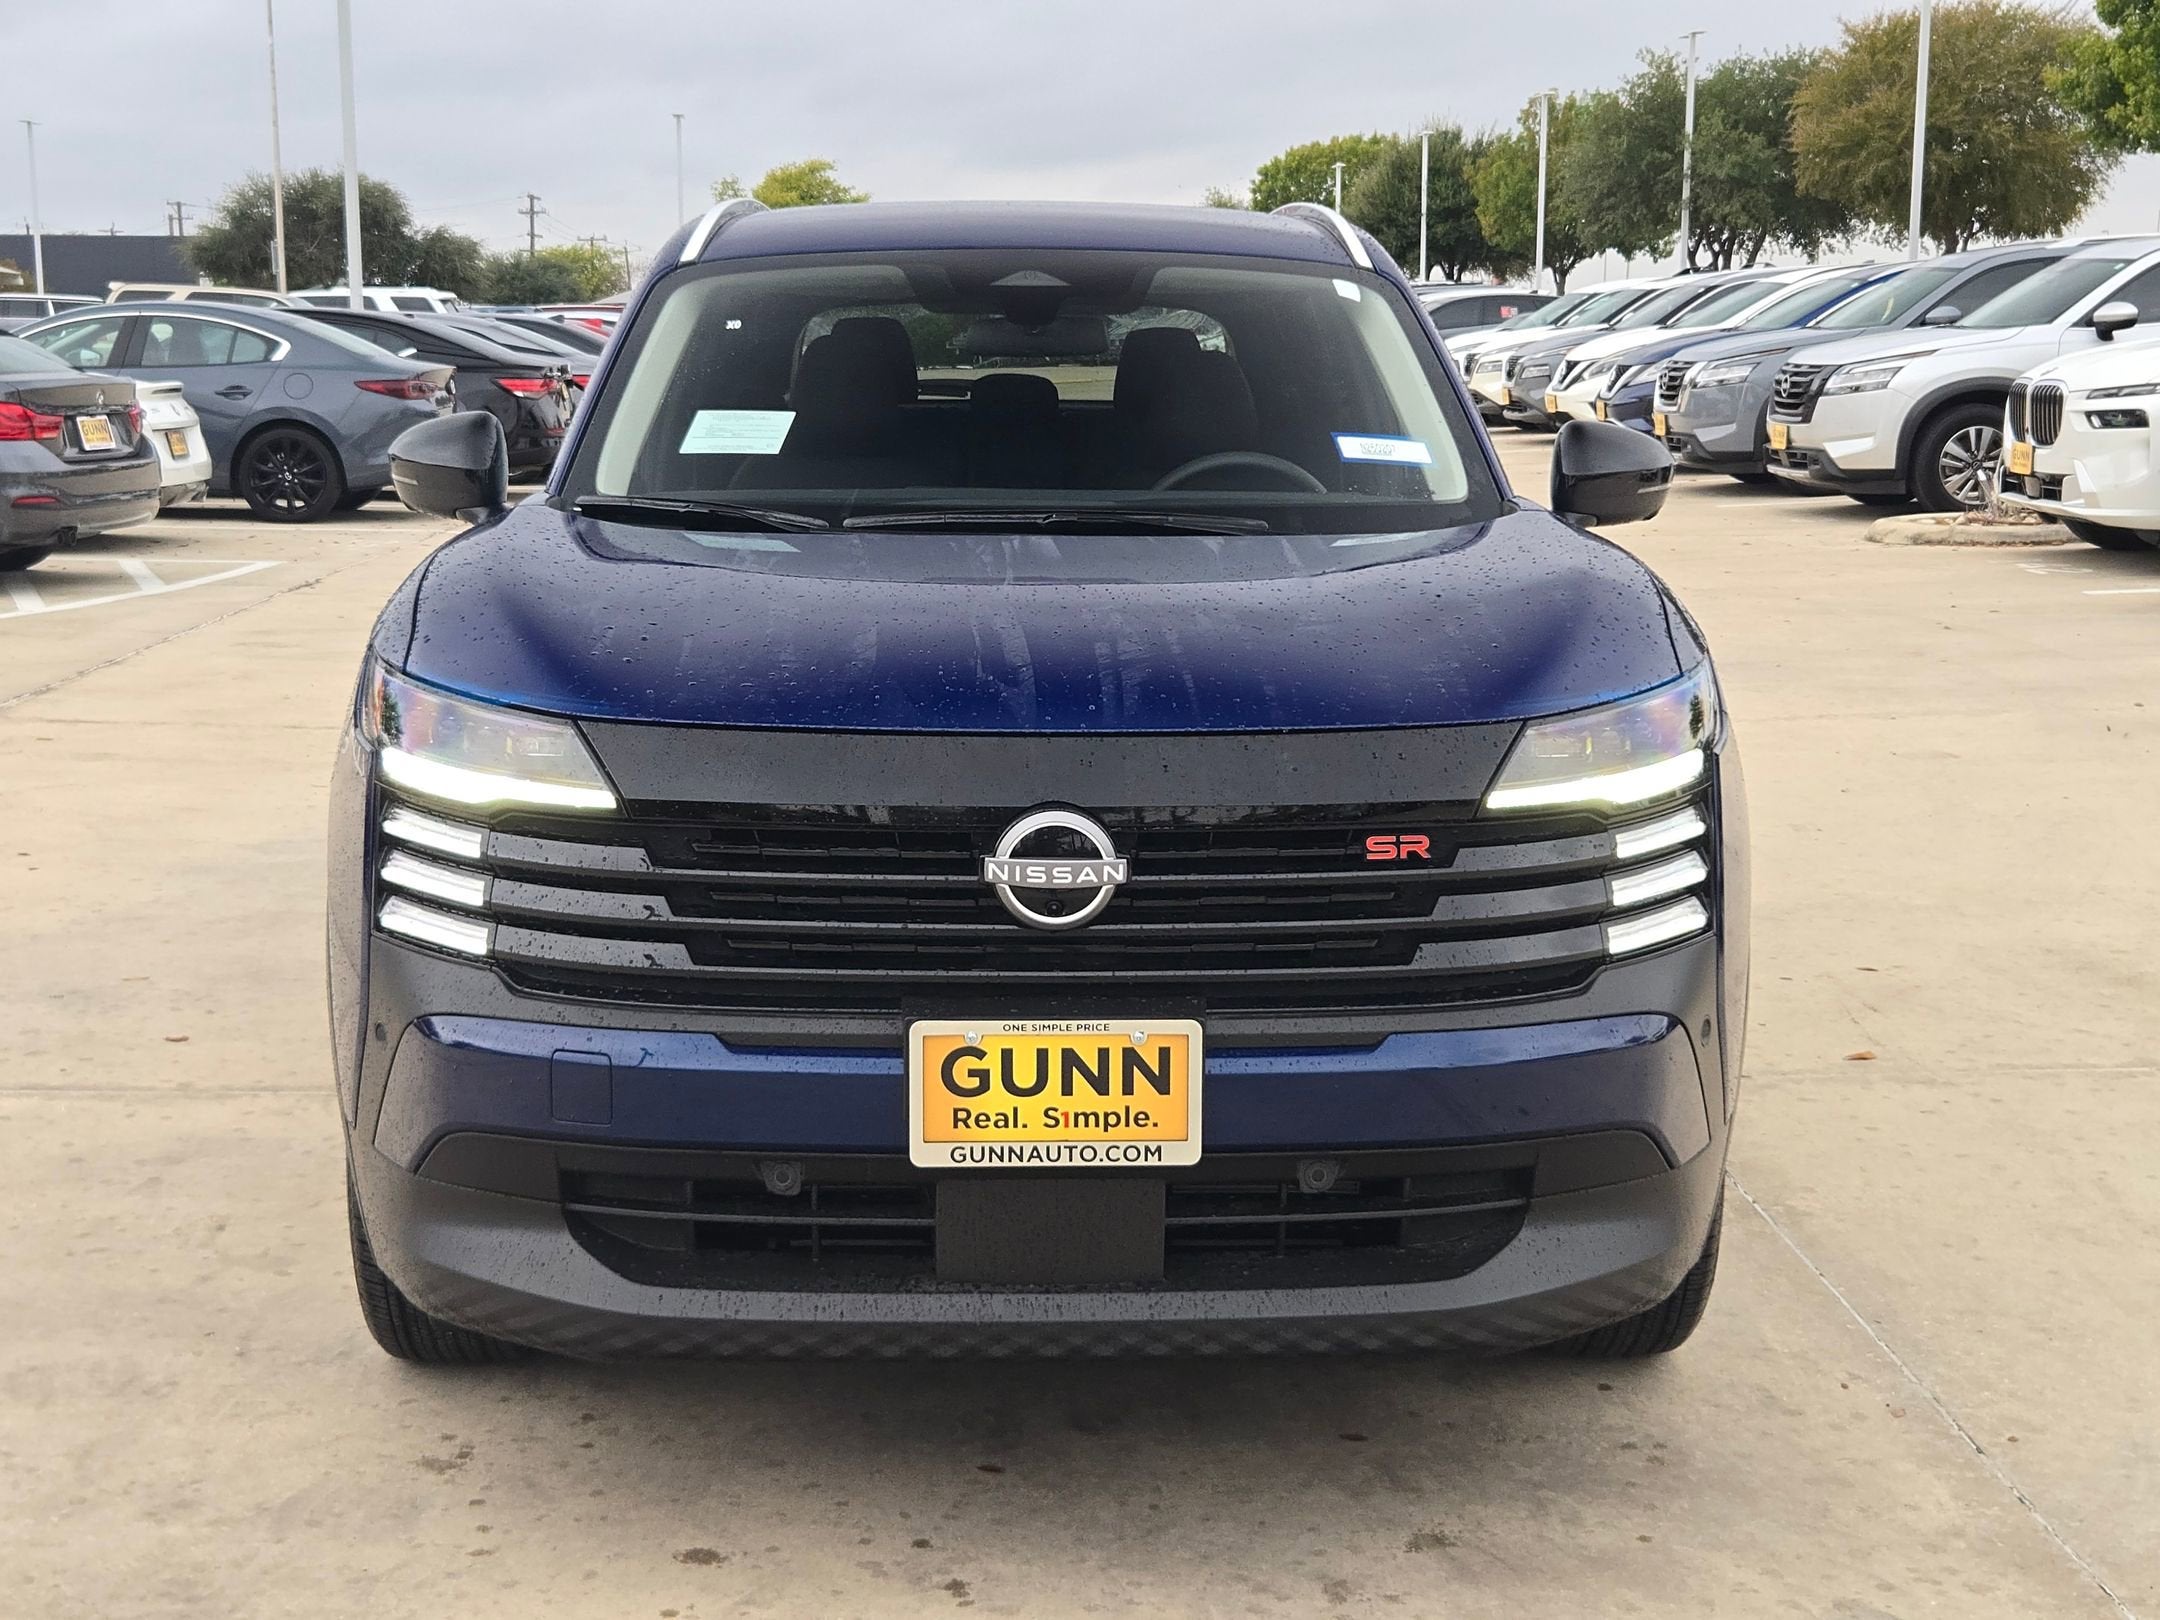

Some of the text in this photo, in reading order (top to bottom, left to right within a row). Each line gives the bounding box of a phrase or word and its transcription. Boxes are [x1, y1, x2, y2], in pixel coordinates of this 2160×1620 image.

[81, 423, 108, 436] GUNN
[1365, 834, 1431, 860] SR
[987, 862, 1125, 884] NISSAN
[1002, 1023, 1110, 1032] ONE SIMPLE PRICE
[940, 1045, 1171, 1098] GUNN
[952, 1106, 1028, 1129] Real.
[950, 1144, 1162, 1163] GUNNAUTO.COM
